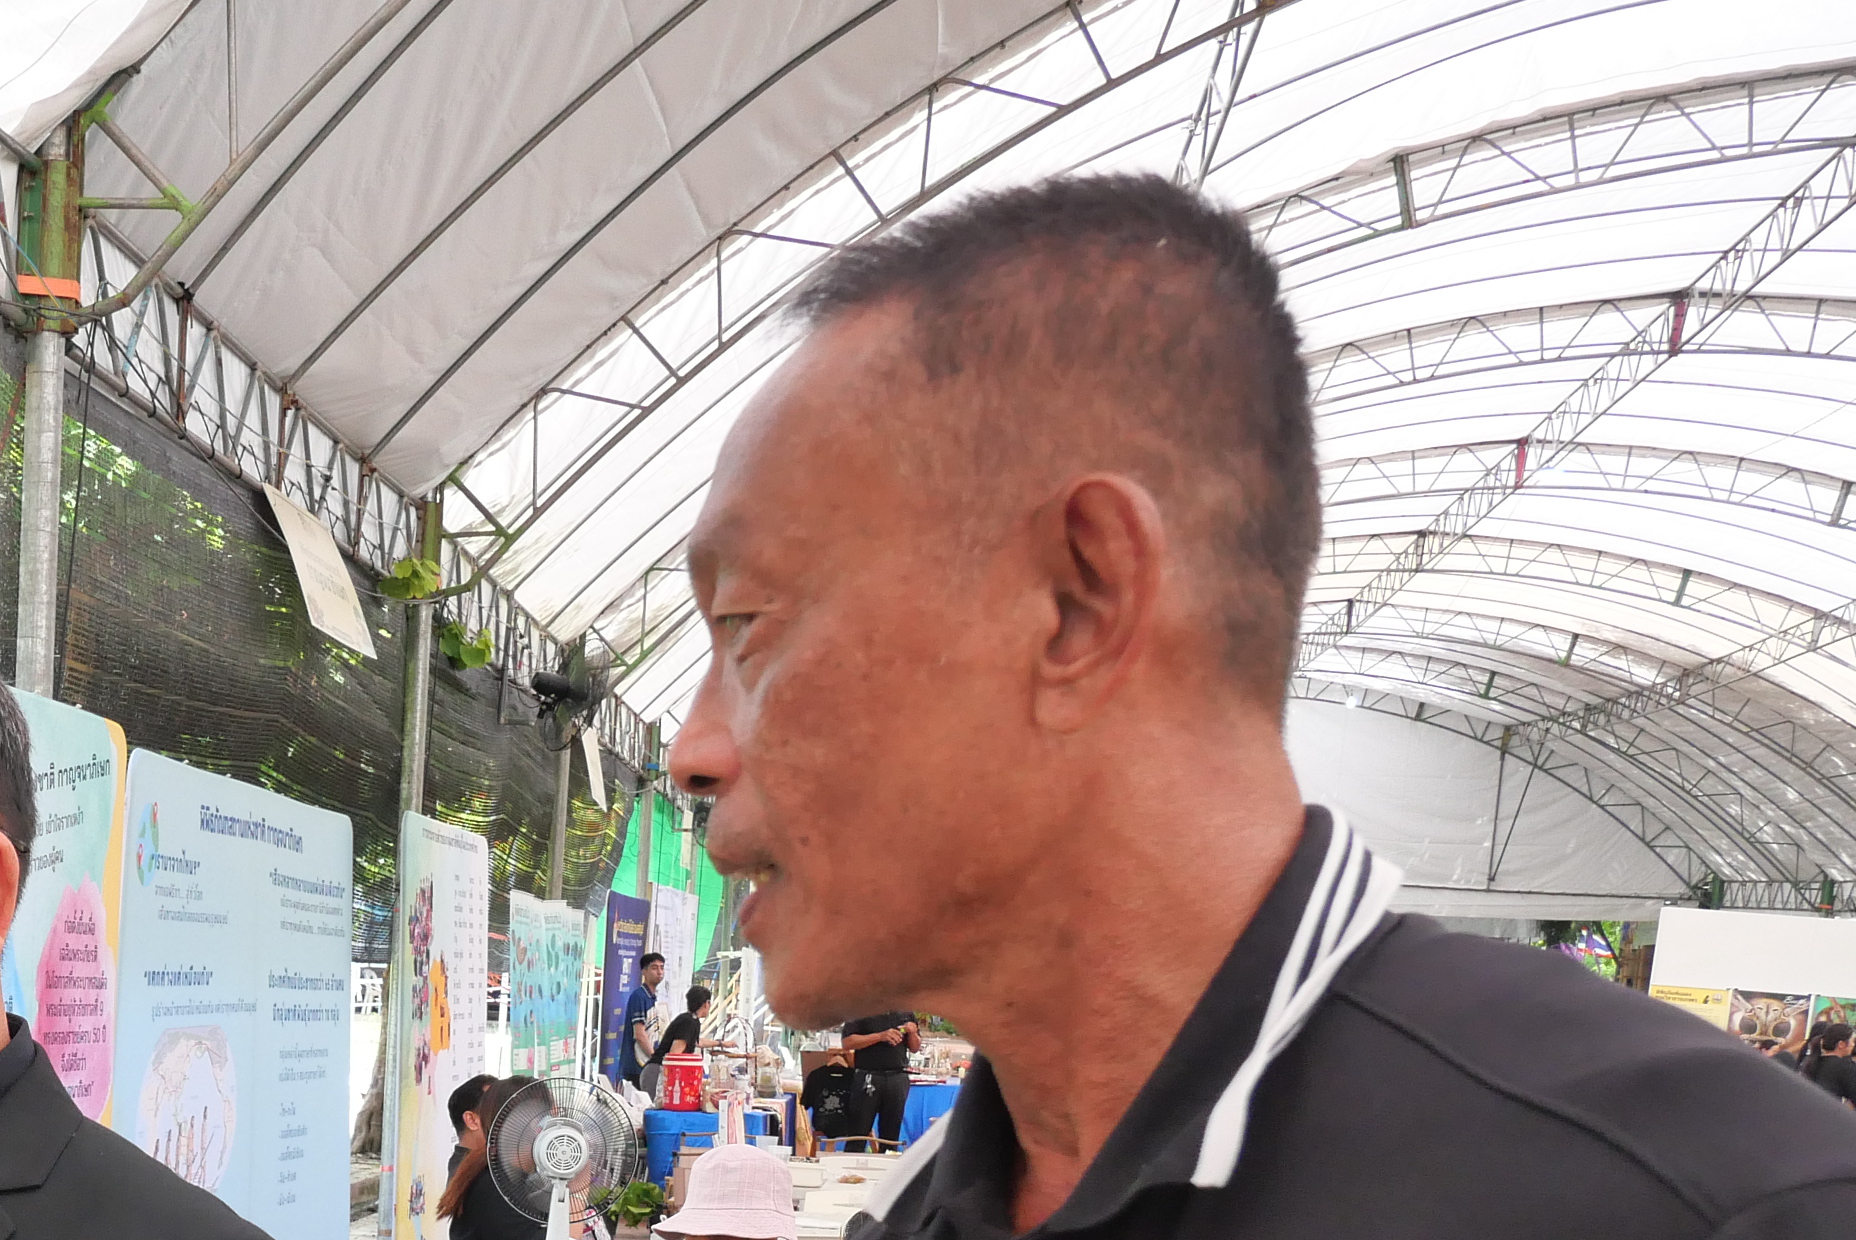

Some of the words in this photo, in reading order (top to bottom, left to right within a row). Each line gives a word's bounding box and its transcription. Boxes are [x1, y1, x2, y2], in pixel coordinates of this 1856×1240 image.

[57, 753, 111, 791] กาญจนาภิเษก
[99, 1001, 104, 1017] 9
